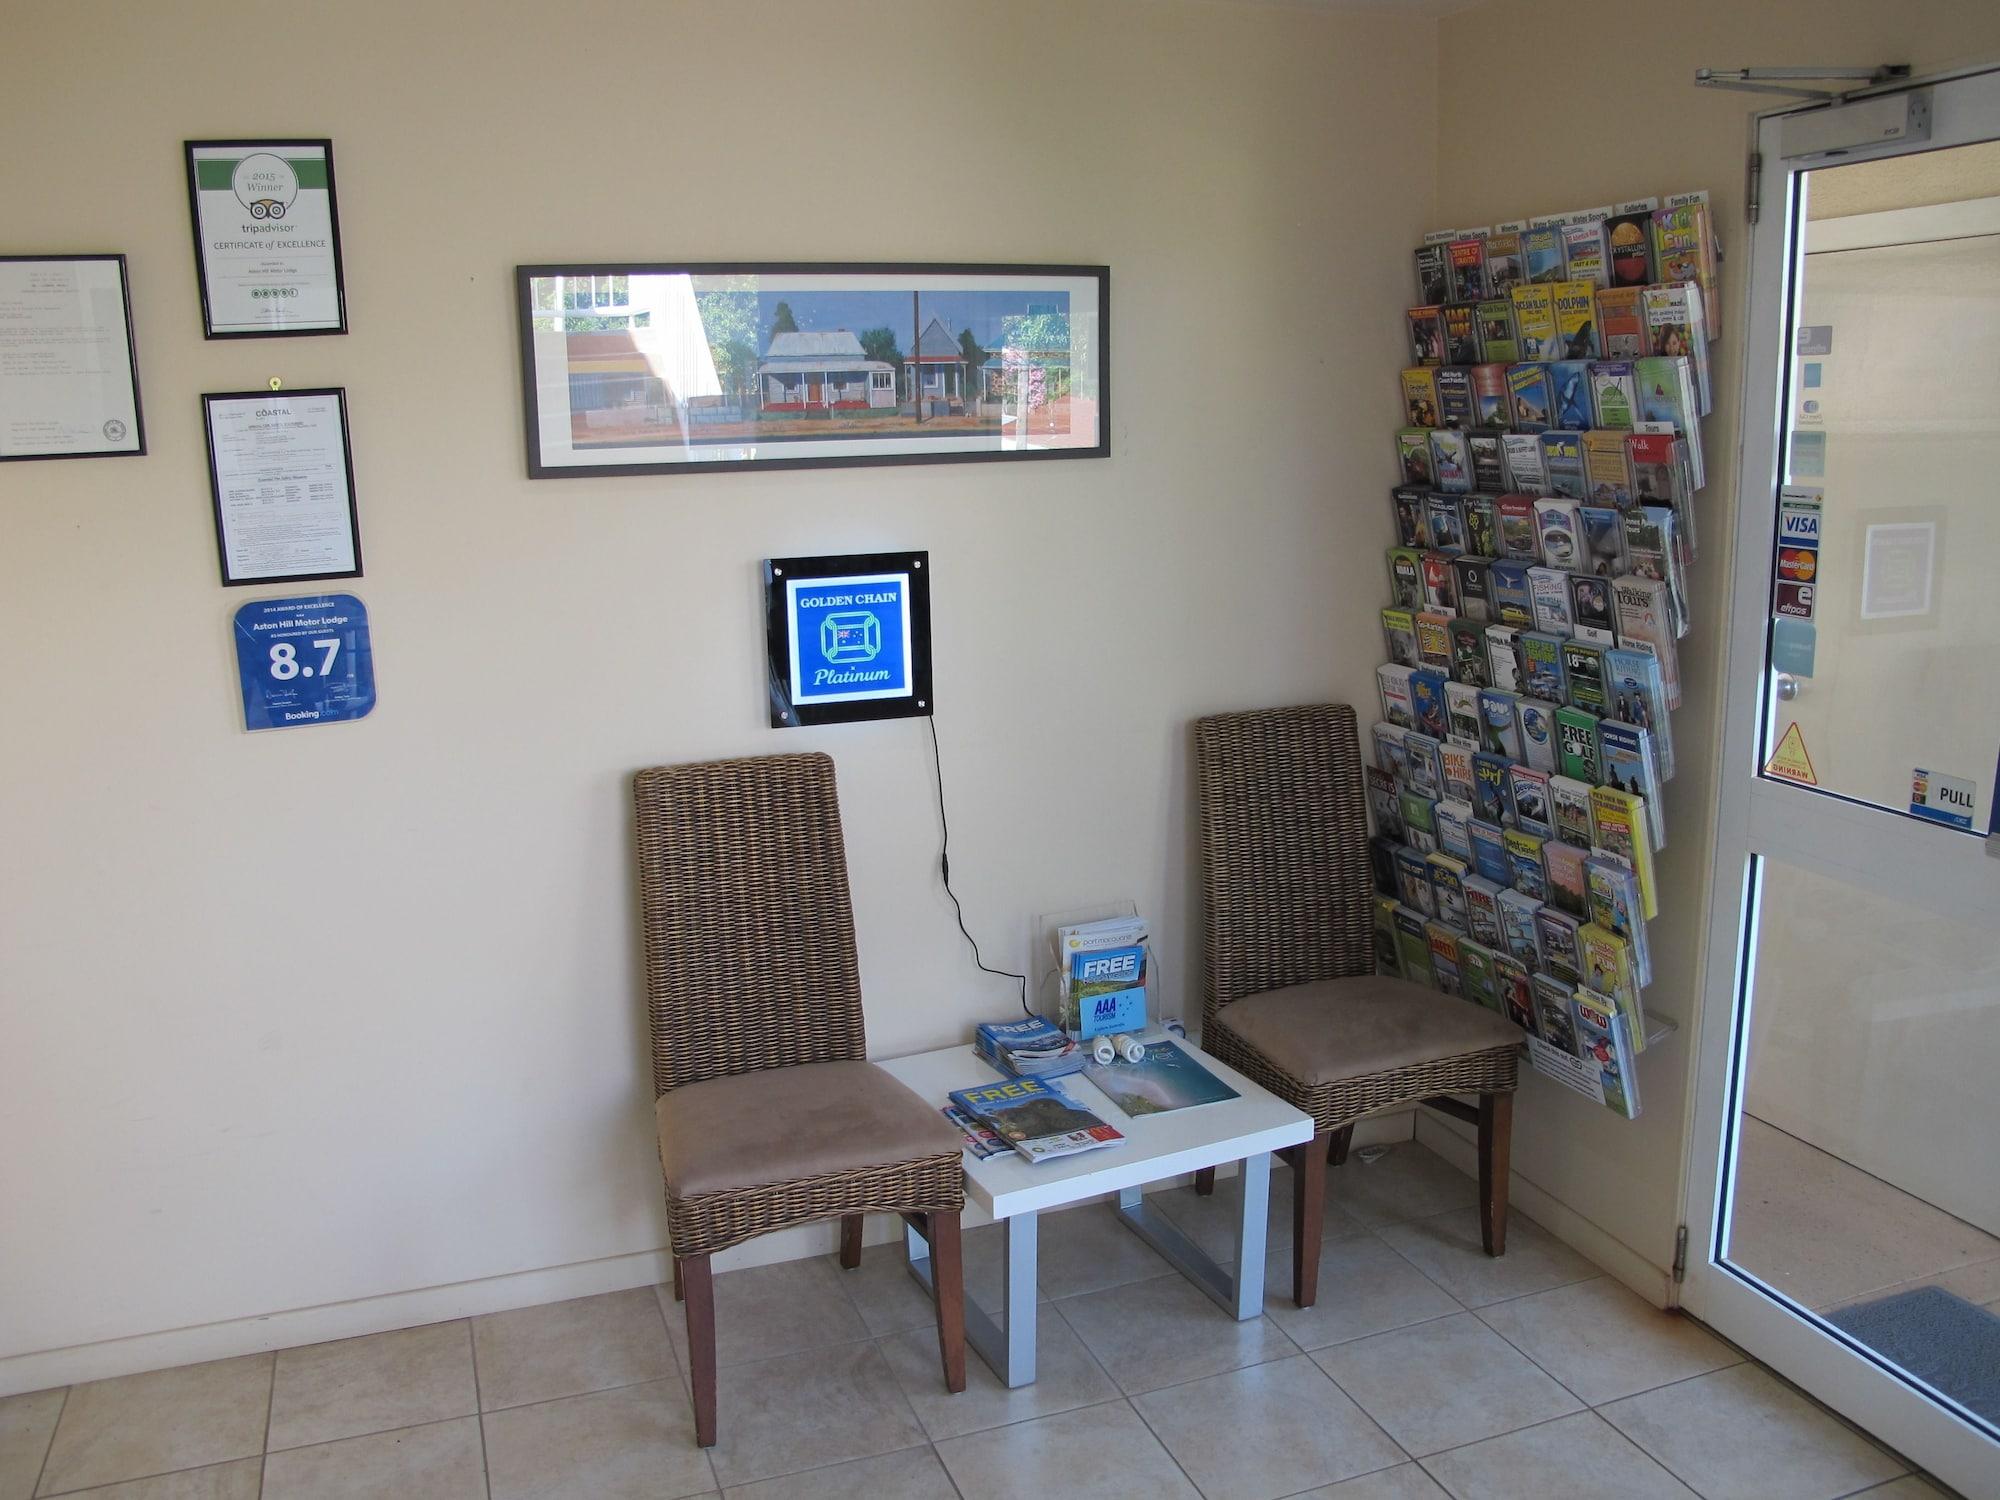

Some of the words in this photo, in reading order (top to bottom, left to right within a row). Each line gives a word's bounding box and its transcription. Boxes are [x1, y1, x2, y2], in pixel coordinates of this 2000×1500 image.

[252, 173, 276, 182] 2015
[246, 182, 284, 192] Winner
[1589, 212, 1608, 222] Sports
[242, 224, 295, 235] tripadvisor
[214, 241, 264, 250] CERTIFICATE
[266, 240, 274, 250] of
[277, 240, 326, 248] EXCELLENCE
[1558, 296, 1589, 310] DOLPHIN
[256, 408, 292, 418] COASTAL
[1645, 424, 1660, 432] Tours
[1628, 438, 1649, 450] Walk
[1785, 516, 1818, 534] VISA
[304, 602, 335, 610] EXCELLENCE
[800, 595, 853, 608] GOLDEN
[855, 592, 897, 605] CHAIN
[1618, 591, 1649, 608] Tours
[1780, 603, 1807, 616] eftpos
[253, 622, 278, 631] Aston
[279, 620, 294, 628] Hill
[294, 618, 321, 628] Motor
[322, 616, 348, 626] Lodge
[1586, 628, 1598, 638] Golf
[270, 638, 340, 680] 8.7
[813, 668, 892, 686] Platinum
[1560, 723, 1593, 746] FREE
[1444, 752, 1465, 767] BIKE
[1940, 788, 1974, 808] PULL
[1084, 954, 1136, 978] FREE
[1094, 997, 1116, 1016] AAA
[988, 1020, 1045, 1033] FREE
[964, 1080, 1046, 1104] FREE
